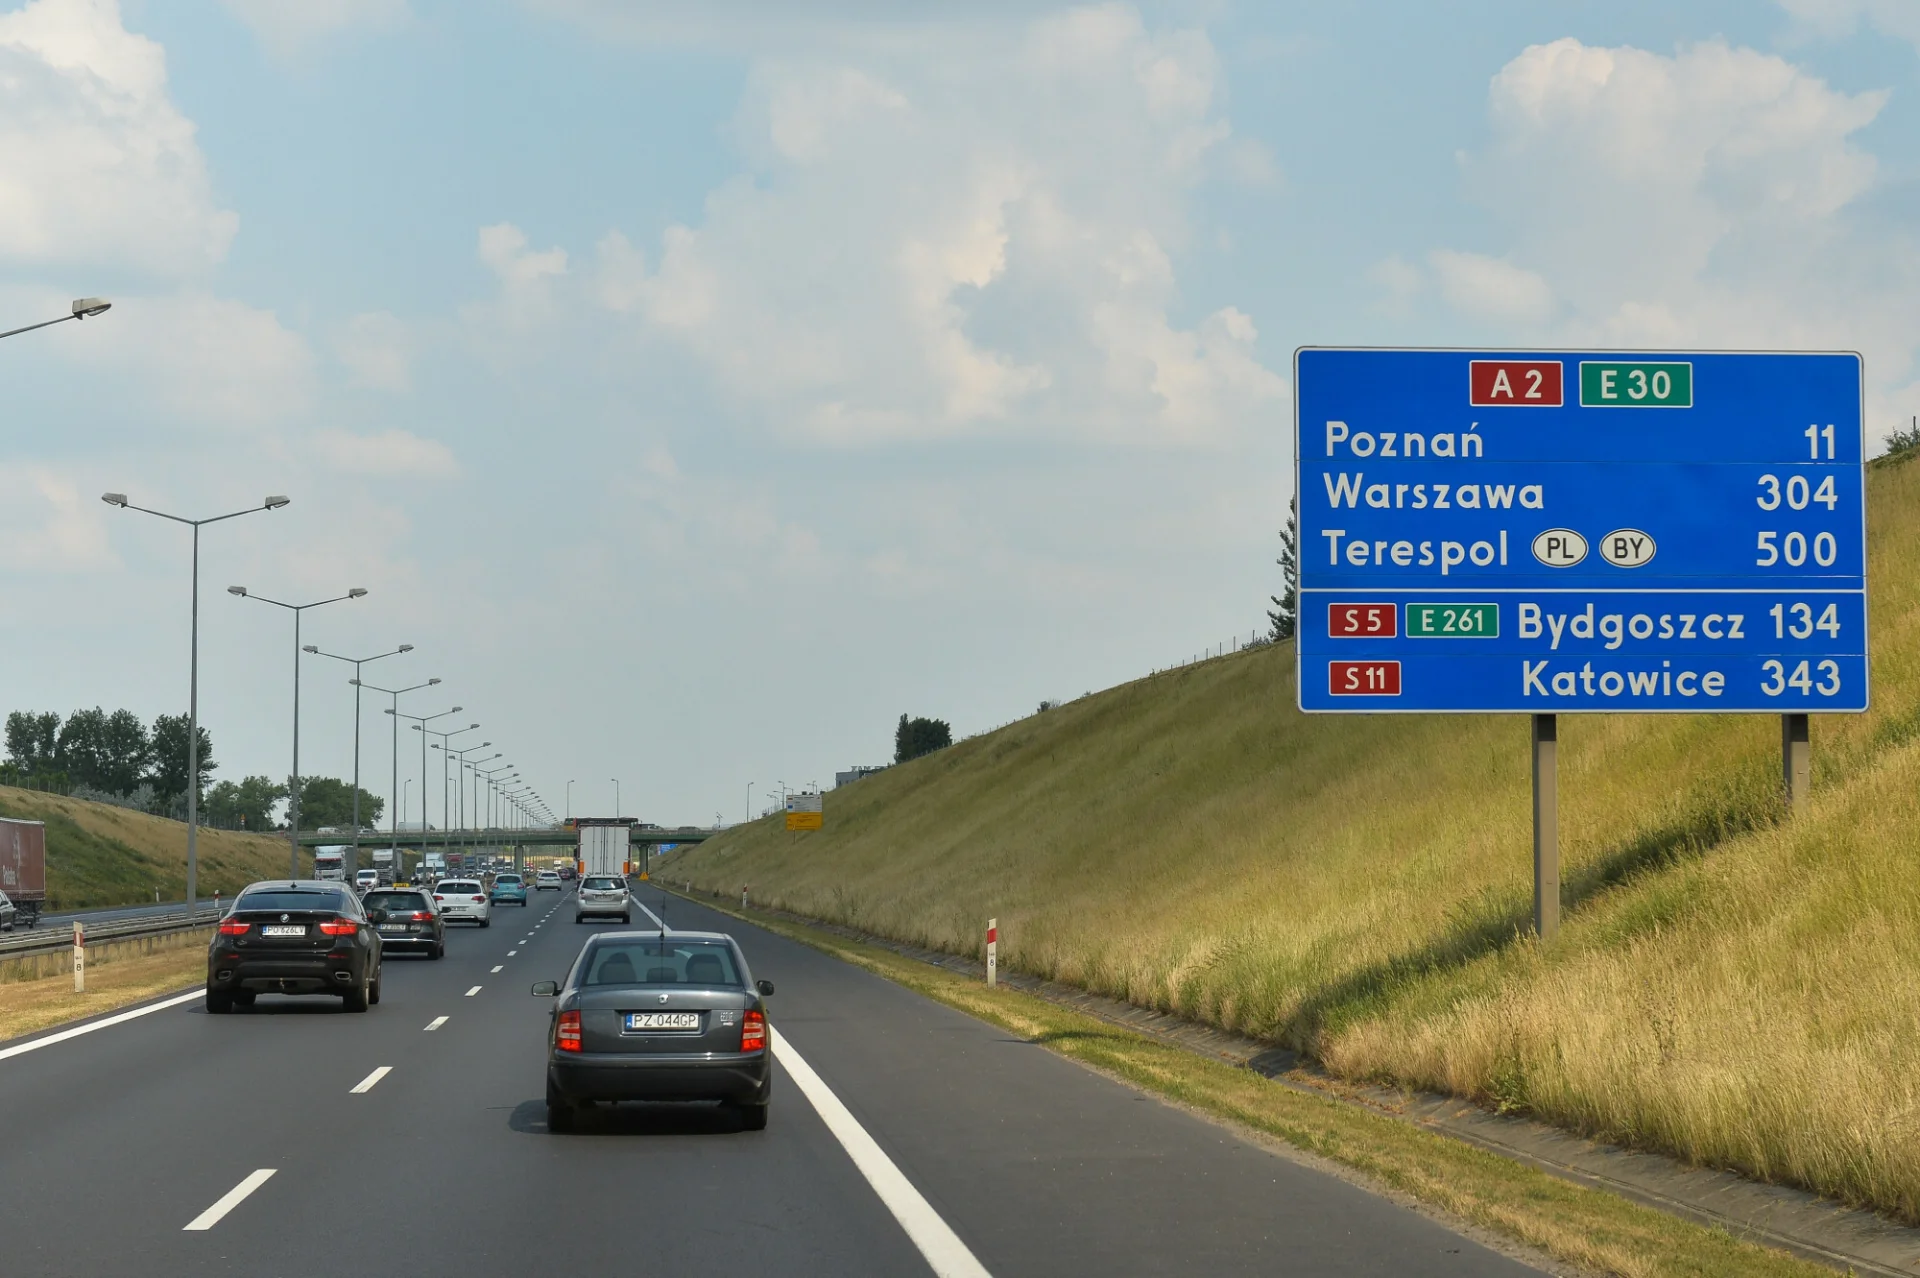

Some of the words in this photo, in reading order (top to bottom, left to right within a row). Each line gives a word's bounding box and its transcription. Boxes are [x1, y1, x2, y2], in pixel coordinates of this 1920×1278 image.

[1490, 369, 1514, 398] A
[1524, 369, 1543, 399] 2
[1601, 369, 1618, 399] E
[1627, 369, 1671, 400] 30
[1325, 421, 1483, 459] Poznań
[1804, 424, 1835, 460] 11
[1323, 472, 1544, 509] Warszawa
[1756, 474, 1838, 511] 304
[1322, 530, 1508, 575] Terespol
[1547, 538, 1574, 559] PL
[1614, 538, 1643, 559] BY
[1756, 531, 1837, 567] 500
[1344, 609, 1359, 632] S
[1367, 609, 1382, 632] 5
[1421, 609, 1435, 632] E
[1442, 609, 1483, 632] 261
[1518, 602, 1745, 650] Bydgoszcz
[1769, 602, 1841, 640] 134
[1344, 666, 1359, 690] S
[1365, 666, 1385, 690] 11
[1522, 660, 1725, 697] Katowice
[1760, 660, 1841, 697] 343
[634, 1014, 653, 1027] PZ
[657, 1014, 697, 1027] 044GP
